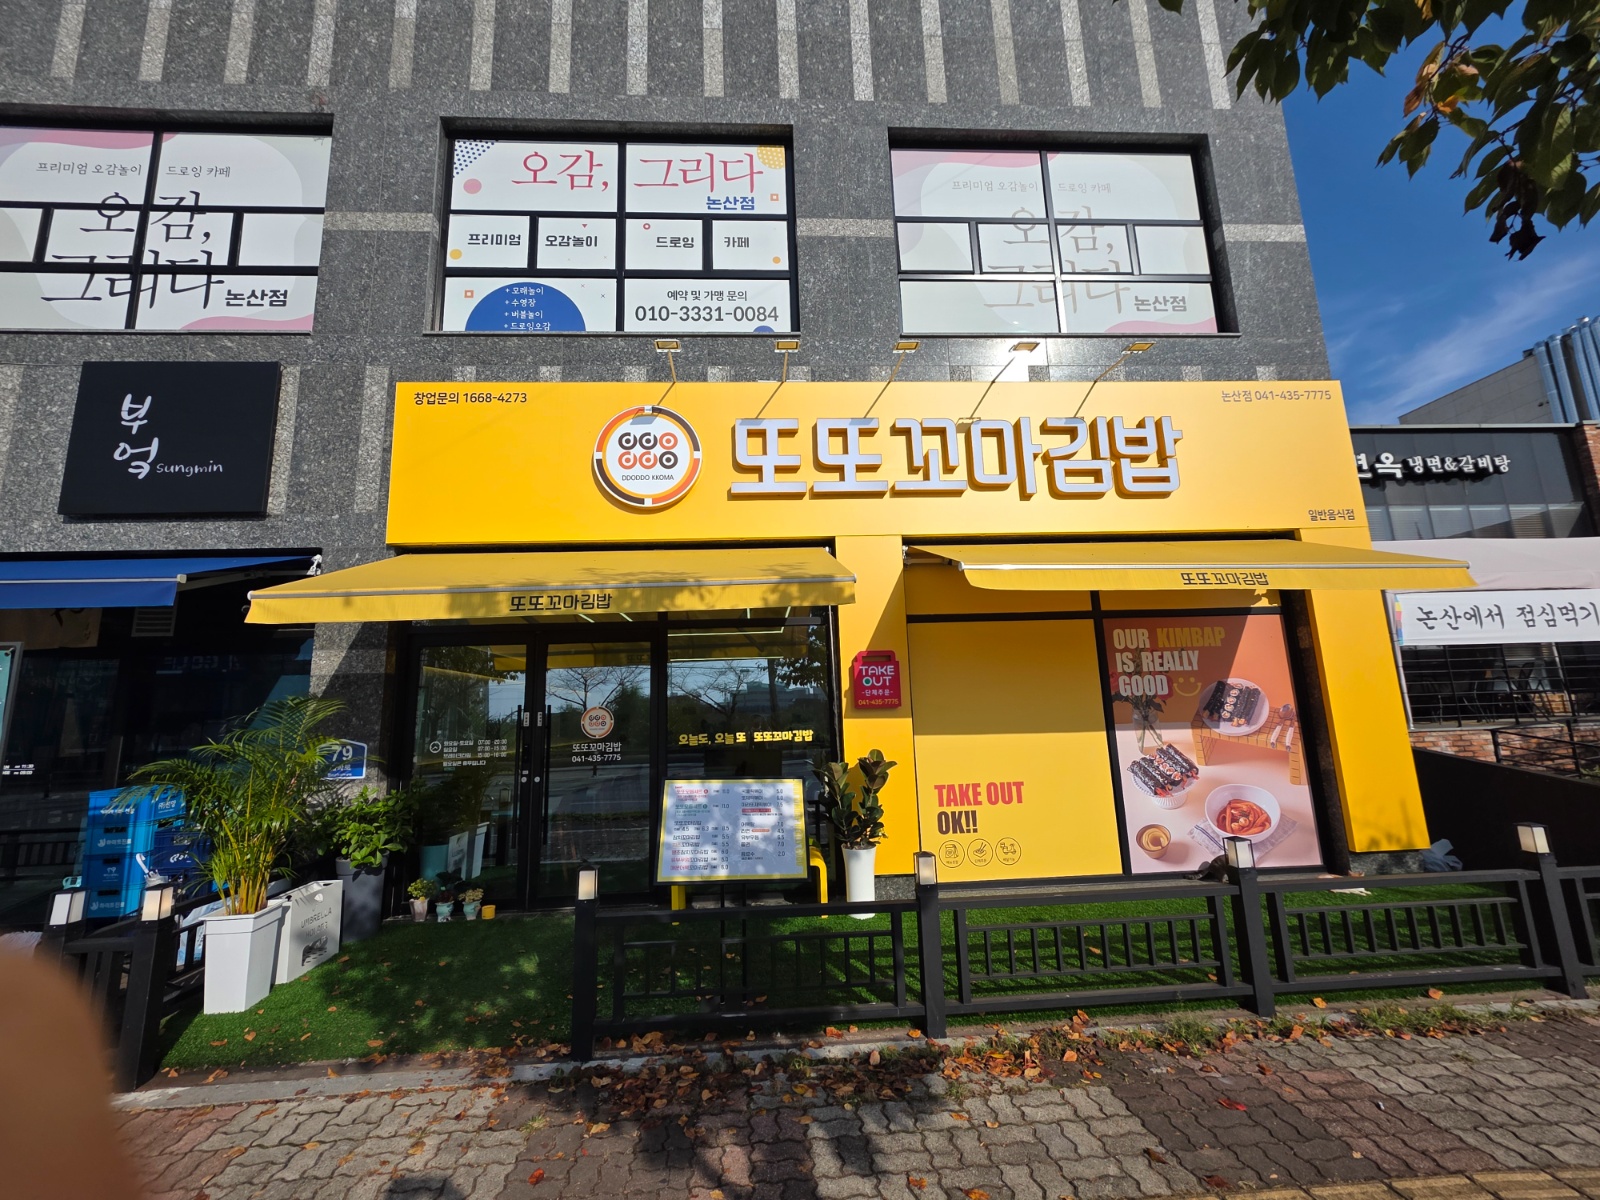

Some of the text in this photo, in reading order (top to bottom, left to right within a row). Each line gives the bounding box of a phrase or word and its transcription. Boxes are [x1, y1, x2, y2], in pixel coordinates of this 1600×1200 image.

[36, 161, 231, 178] 프리미엄 오감놀이 드로잉 카페
[511, 149, 764, 193] 오감, 그리다
[952, 180, 1111, 194] 프리미엄 오감놀이 드로잉 카페
[706, 196, 755, 211] 논산점
[467, 233, 750, 249] 프리미엄 오감놀이 드로잉 카페
[224, 289, 289, 308] 논산점
[512, 287, 544, 295] 모래놀이
[667, 290, 748, 301] 예약 및 가맹 문의
[511, 298, 536, 307] 수영장
[1134, 295, 1187, 312] 논산점
[511, 310, 543, 319] 버블놀이
[635, 305, 779, 322] 010-3331-0084
[414, 391, 527, 405] 창업문의 1668-4273
[1221, 389, 1331, 403] 논산점 041-435-7775
[729, 416, 1183, 496] 또또꼬마김밥
[1407, 455, 1511, 473] 냉면&갈비탕
[156, 460, 223, 477] sungmin
[1307, 508, 1355, 521] 일반음식점
[1181, 572, 1269, 586] 또또꼬마김밥
[509, 592, 612, 612] 또또꼬마김밥
[1416, 604, 1504, 630] 논산에서
[1113, 626, 1226, 650] OUR KIMBAP
[859, 665, 895, 675] TAKE
[1116, 650, 1199, 673] IS REALLY
[862, 676, 892, 687] OUT
[1119, 675, 1169, 697] GOOD
[678, 733, 711, 746] 오늘도,
[753, 729, 814, 743] 또또꼬마김밥
[572, 741, 622, 752] 또또꼬마김밥
[572, 754, 621, 762] 041-435-7775
[934, 781, 1024, 807] TAKE OUT
[937, 810, 978, 835] OK!!
[301, 907, 332, 928] UMBRELLA
